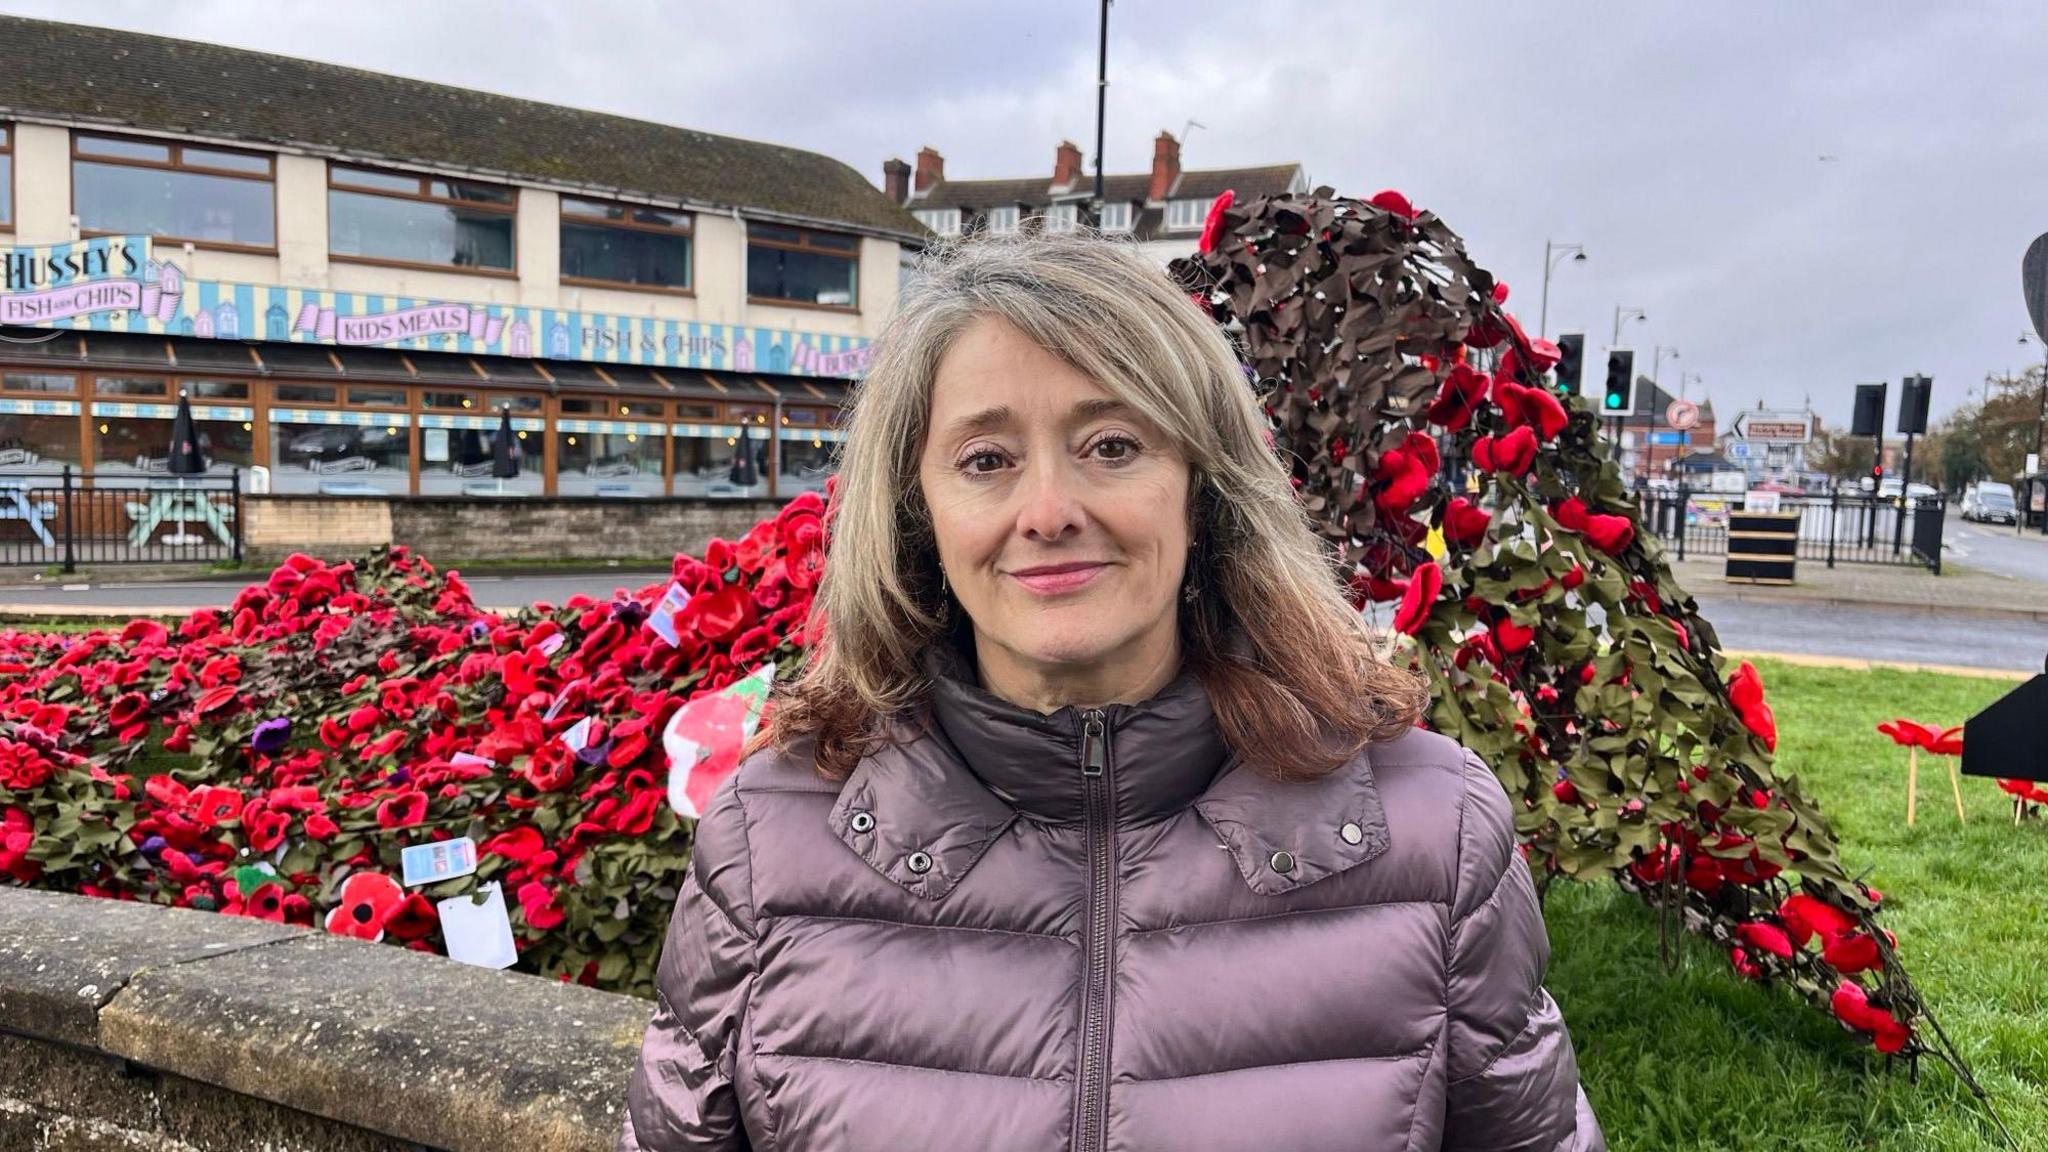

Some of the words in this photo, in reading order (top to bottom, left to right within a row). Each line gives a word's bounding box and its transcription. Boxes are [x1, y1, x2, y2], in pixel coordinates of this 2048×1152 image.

[4, 242, 137, 289] HUSSEY'S
[8, 298, 52, 319] FISH
[74, 284, 133, 311] CHIPS
[345, 318, 393, 340] KIDS
[397, 309, 462, 335] MEALS
[582, 326, 632, 350] FISH
[639, 334, 658, 353] &
[663, 334, 728, 357] CHIPS
